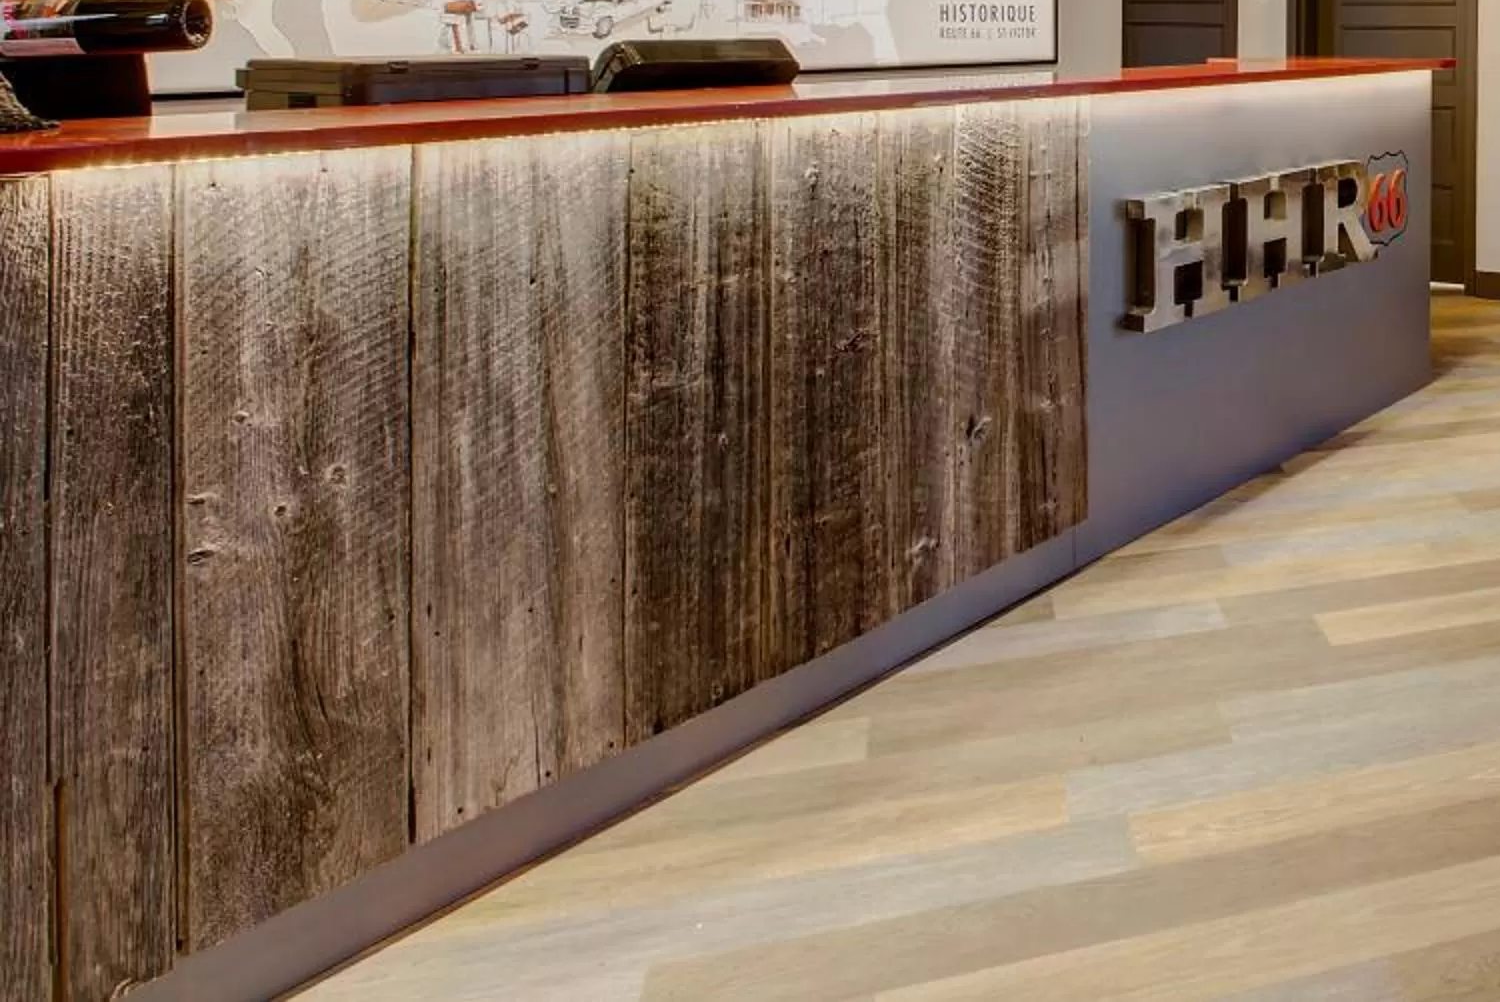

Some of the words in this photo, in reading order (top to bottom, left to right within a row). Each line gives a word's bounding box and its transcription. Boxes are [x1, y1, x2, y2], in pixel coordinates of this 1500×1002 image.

[939, 3, 1036, 23] HISTORIQUE
[1126, 159, 1378, 333] HHR
[1366, 169, 1407, 232] 66
